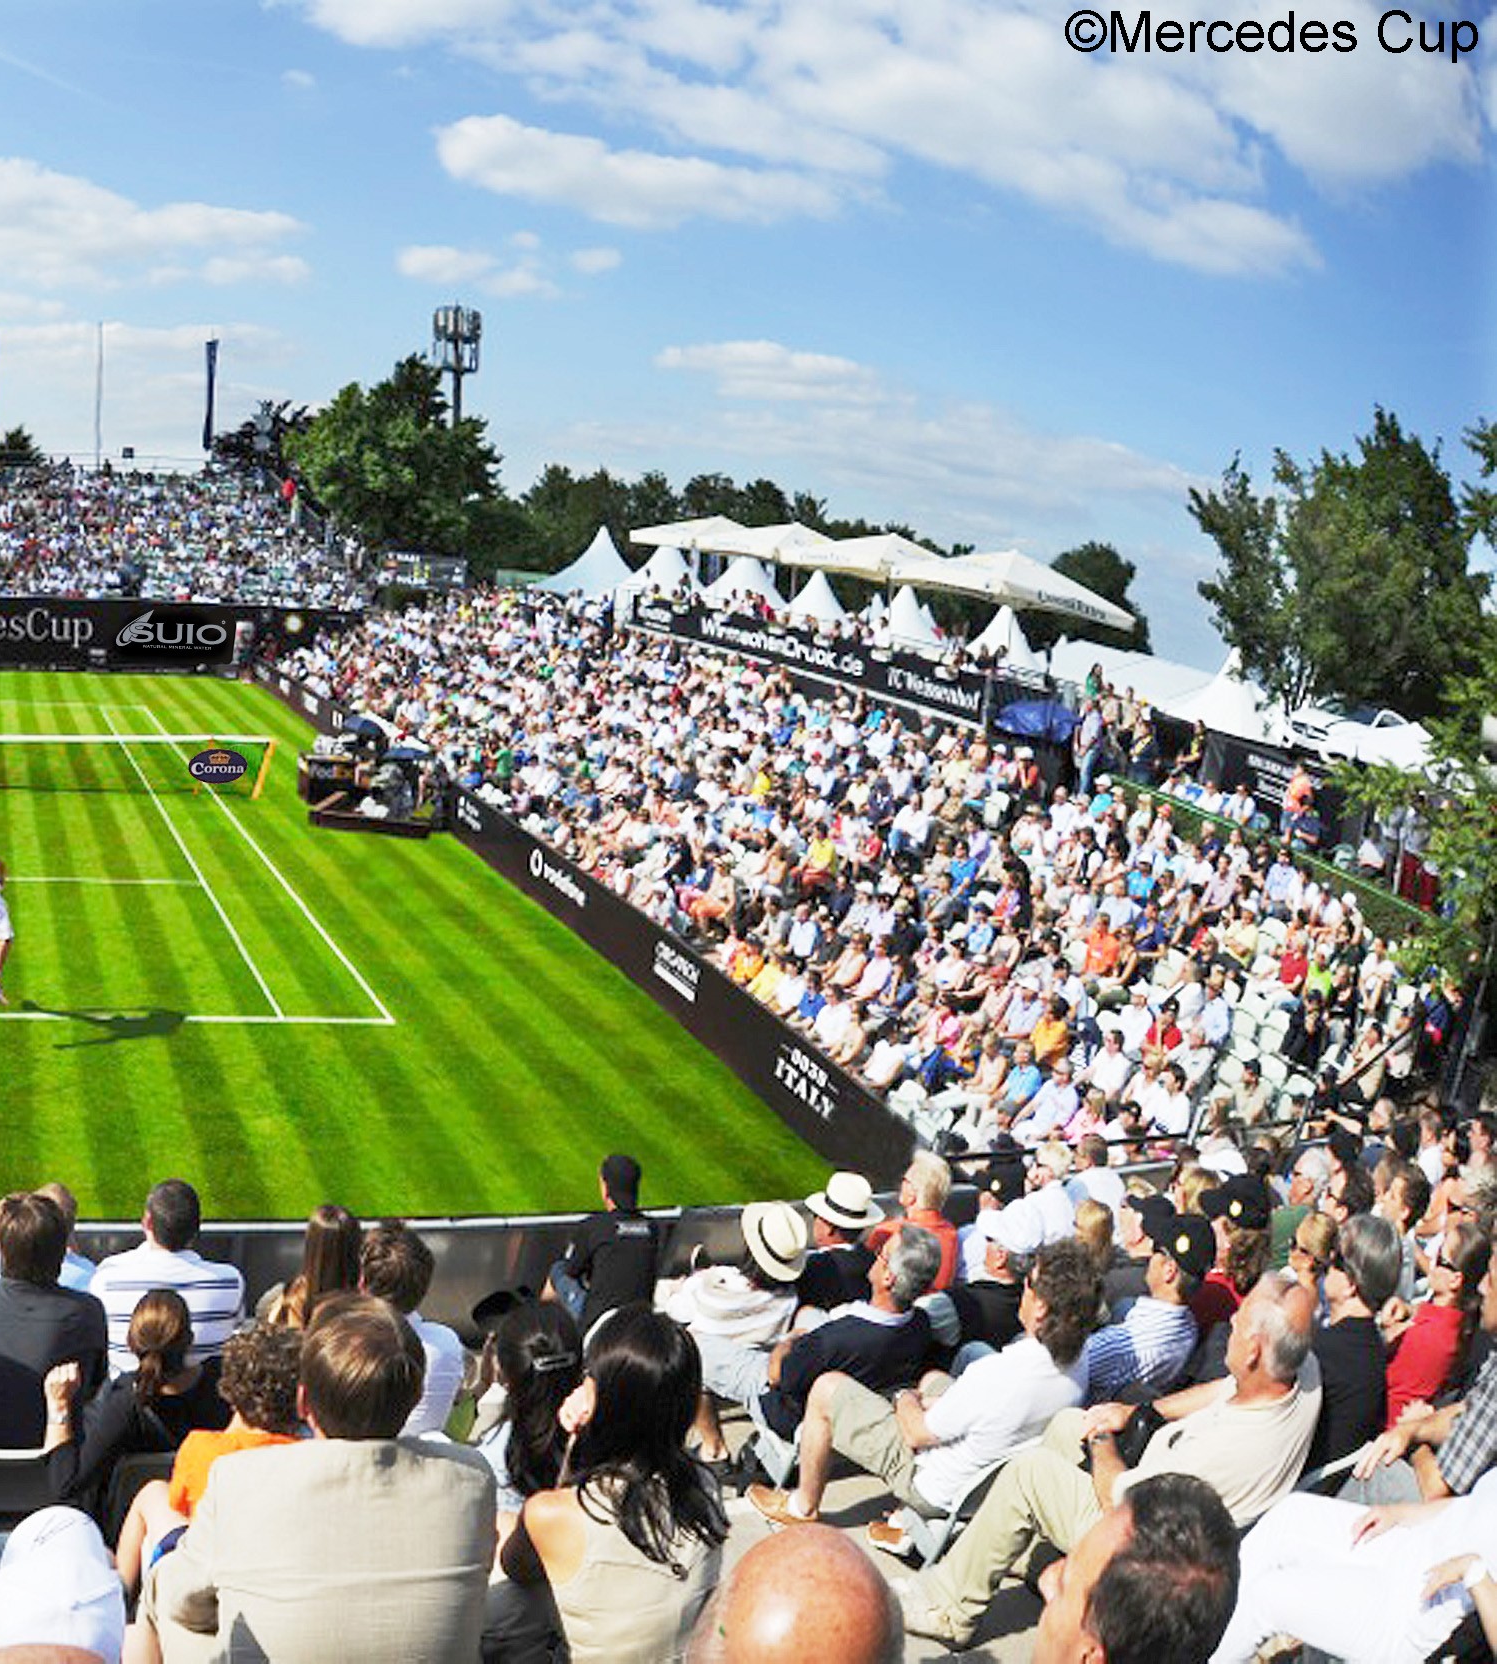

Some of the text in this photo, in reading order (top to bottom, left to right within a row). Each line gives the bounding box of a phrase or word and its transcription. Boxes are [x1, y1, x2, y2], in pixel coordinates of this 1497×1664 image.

[127, 621, 227, 646] SUIO
[190, 762, 245, 775] Corona
[774, 1057, 835, 1120] ITALY
